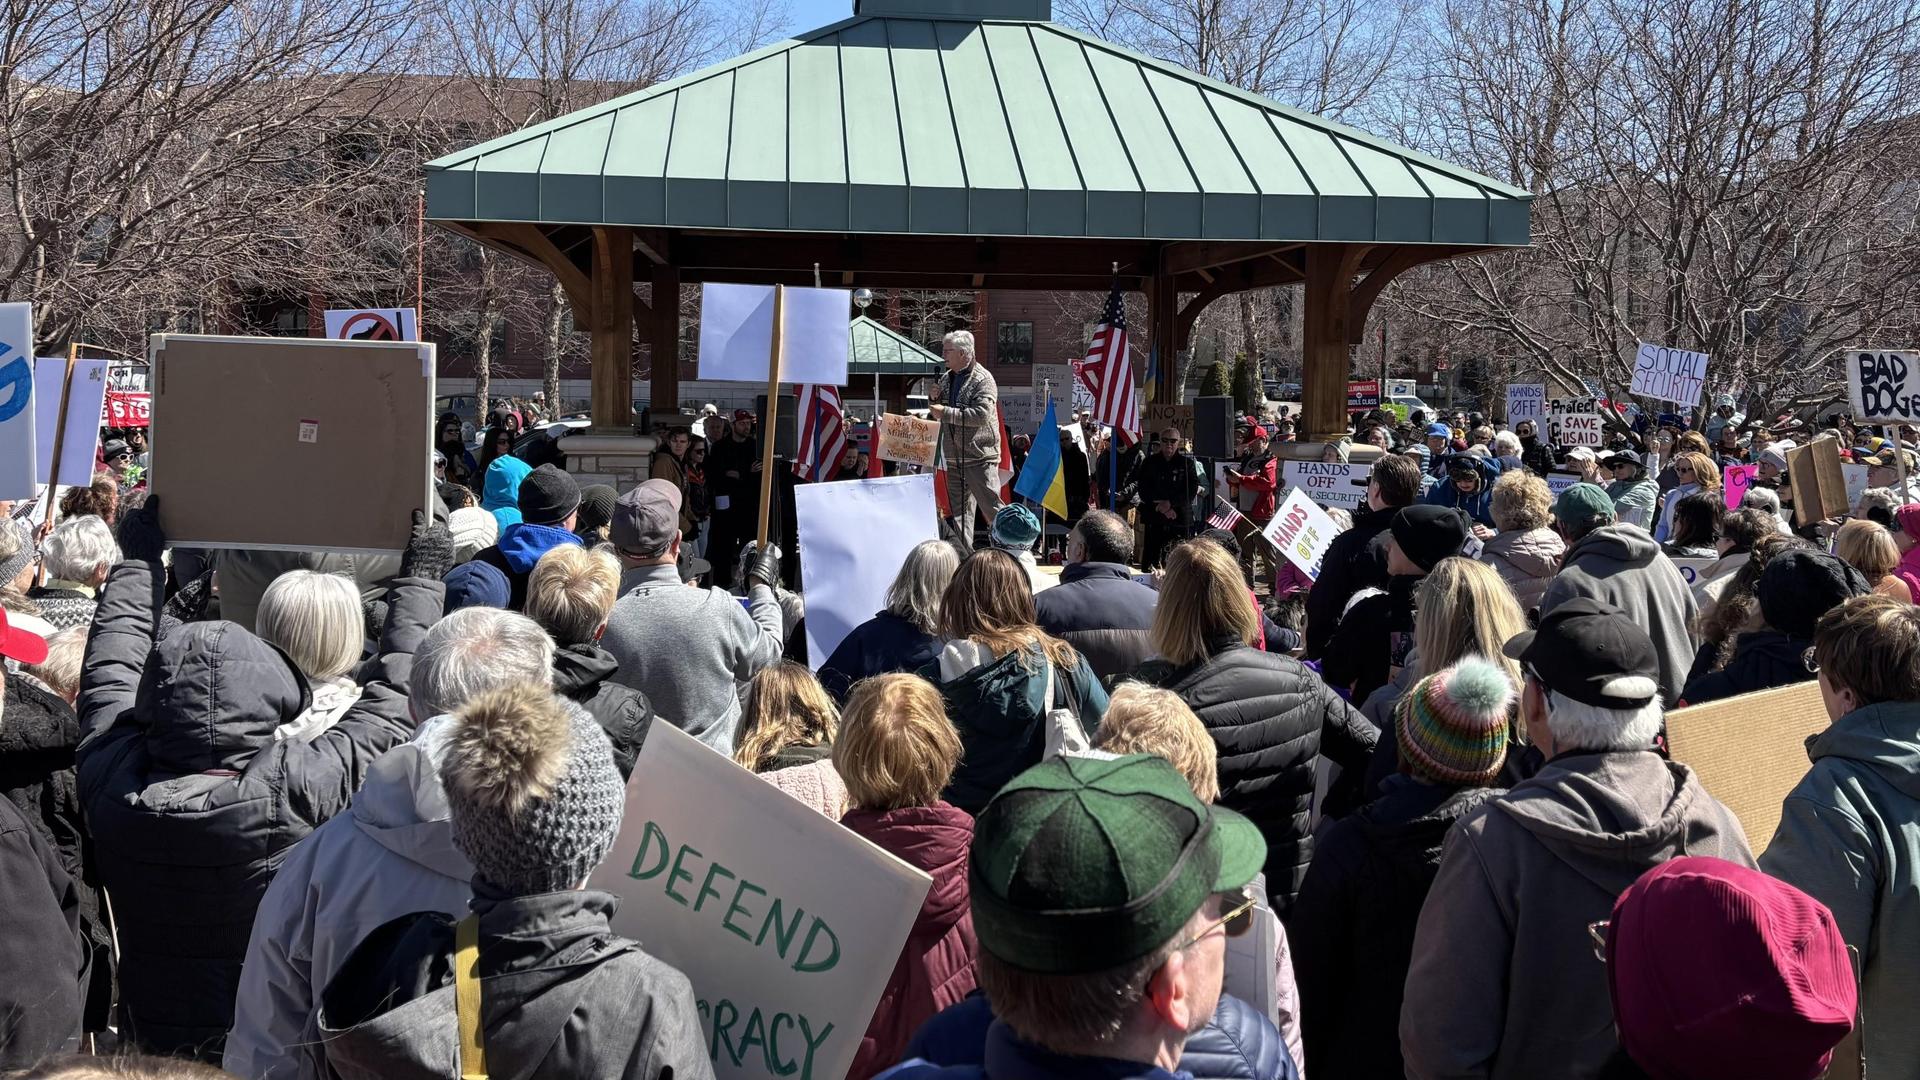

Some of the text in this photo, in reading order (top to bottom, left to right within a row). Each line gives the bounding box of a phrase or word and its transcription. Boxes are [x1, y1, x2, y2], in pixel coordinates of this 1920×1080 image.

[1639, 345, 1702, 380] SOCIAL
[1859, 353, 1907, 385] BAD
[1510, 387, 1541, 397] HANDS
[1632, 369, 1703, 404] SECURITY
[1153, 406, 1175, 420] NO
[1565, 417, 1598, 430] SAVE
[1563, 432, 1598, 444] USAID
[1298, 463, 1350, 476] HANDS
[1307, 476, 1336, 488] OFF
[1271, 503, 1308, 551] HANDS
[1297, 526, 1320, 560] OFF
[626, 821, 841, 973] DEFEND
